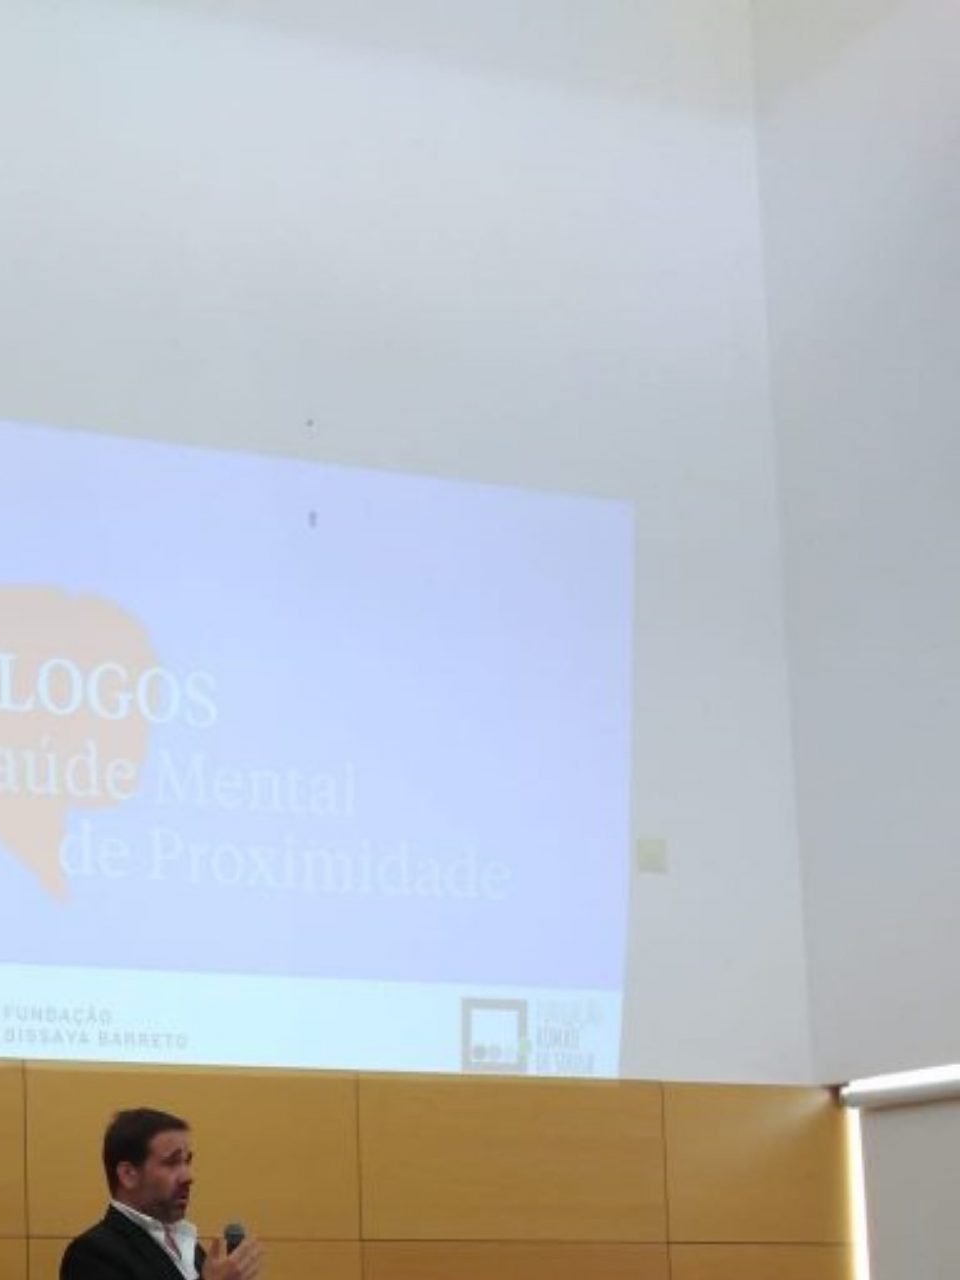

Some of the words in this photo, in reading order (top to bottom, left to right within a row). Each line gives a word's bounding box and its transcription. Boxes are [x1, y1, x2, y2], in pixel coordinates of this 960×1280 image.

[156, 748, 357, 818] Mental
[57, 818, 130, 879] de
[146, 826, 513, 900] Proximidade
[3, 1003, 113, 1025] FUNDAÇÃO
